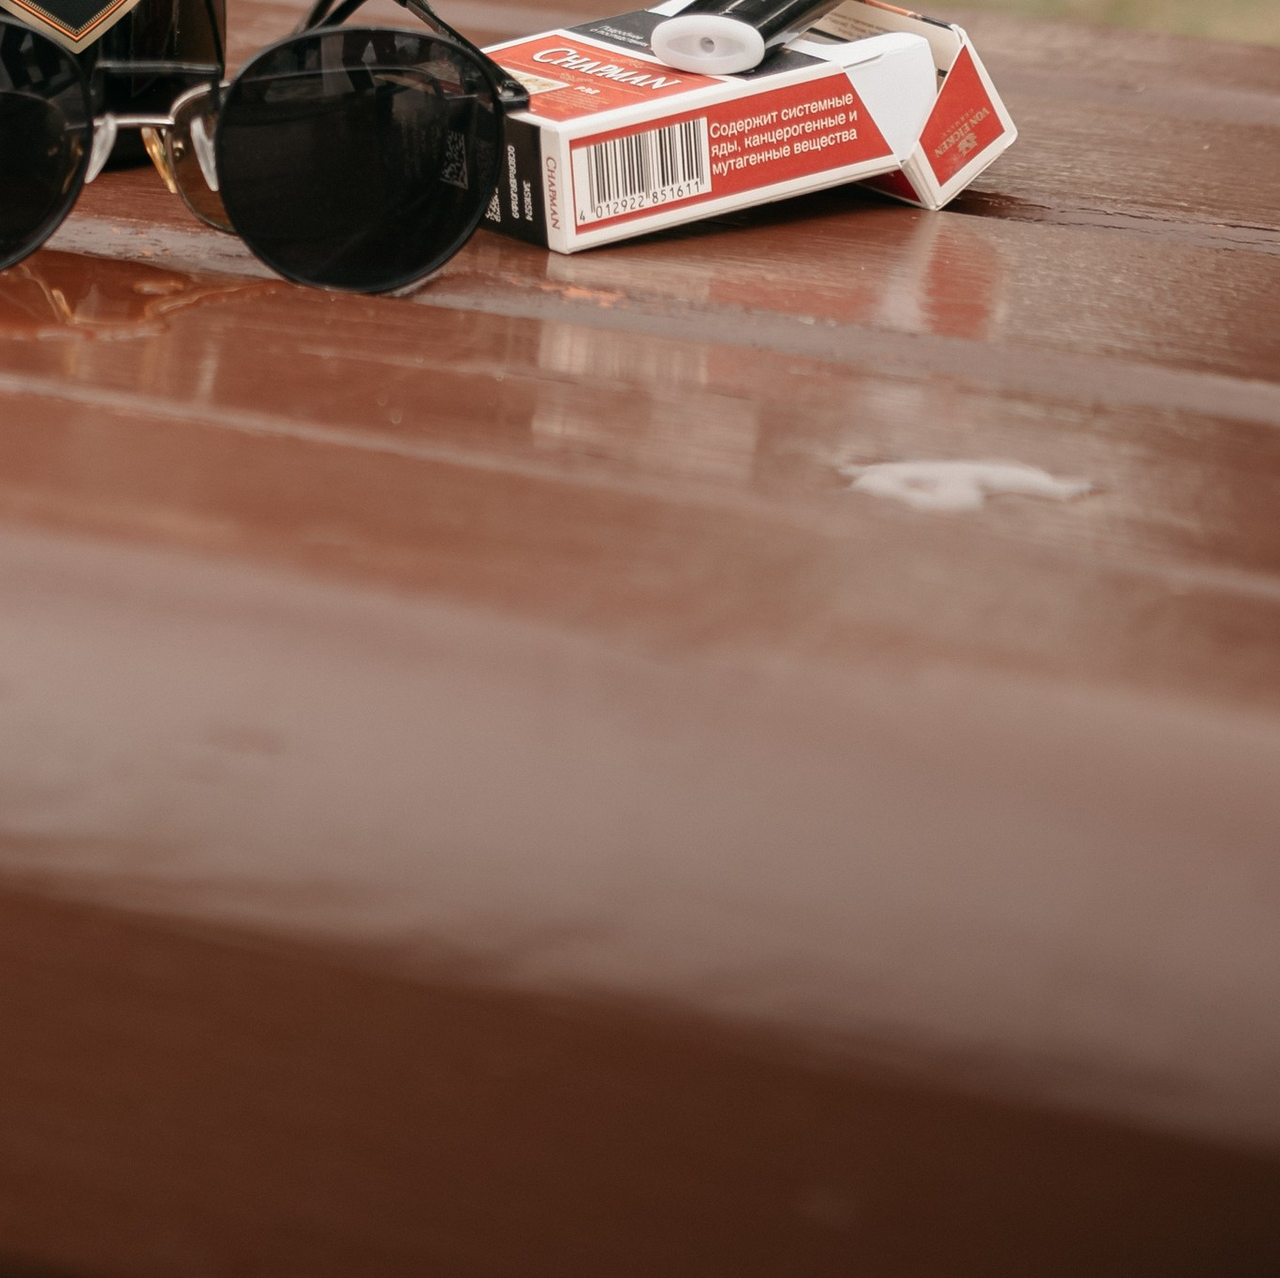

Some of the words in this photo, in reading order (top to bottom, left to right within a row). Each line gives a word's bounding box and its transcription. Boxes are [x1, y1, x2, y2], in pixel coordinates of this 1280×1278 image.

[532, 47, 681, 90] CHAPMAN
[709, 111, 778, 139] Содержит
[781, 93, 853, 121] системные
[711, 134, 742, 157] яды,
[744, 113, 846, 149] канцерогенные
[849, 110, 858, 122] и
[712, 145, 791, 176] мутагенные
[793, 129, 858, 155] вещества
[546, 156, 560, 230] CHAPMAN
